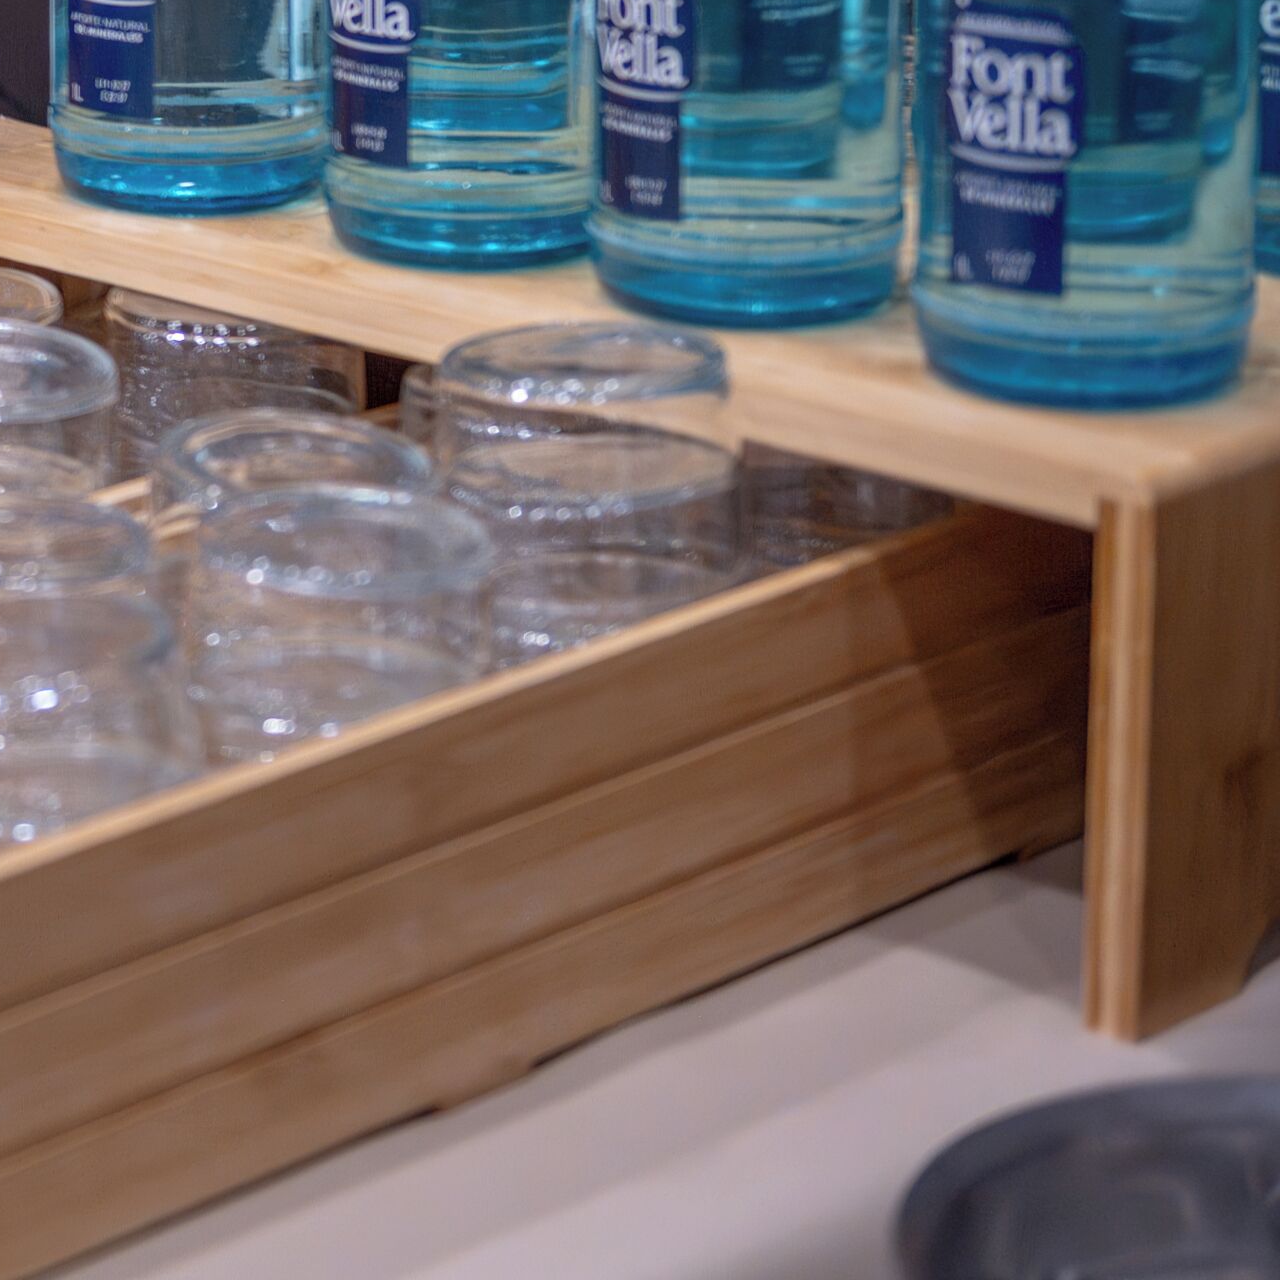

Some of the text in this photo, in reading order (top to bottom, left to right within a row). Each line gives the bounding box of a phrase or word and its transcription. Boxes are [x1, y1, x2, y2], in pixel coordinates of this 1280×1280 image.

[596, 24, 690, 89] Vella
[950, 33, 1074, 103] Font
[948, 87, 1077, 155] Vella
